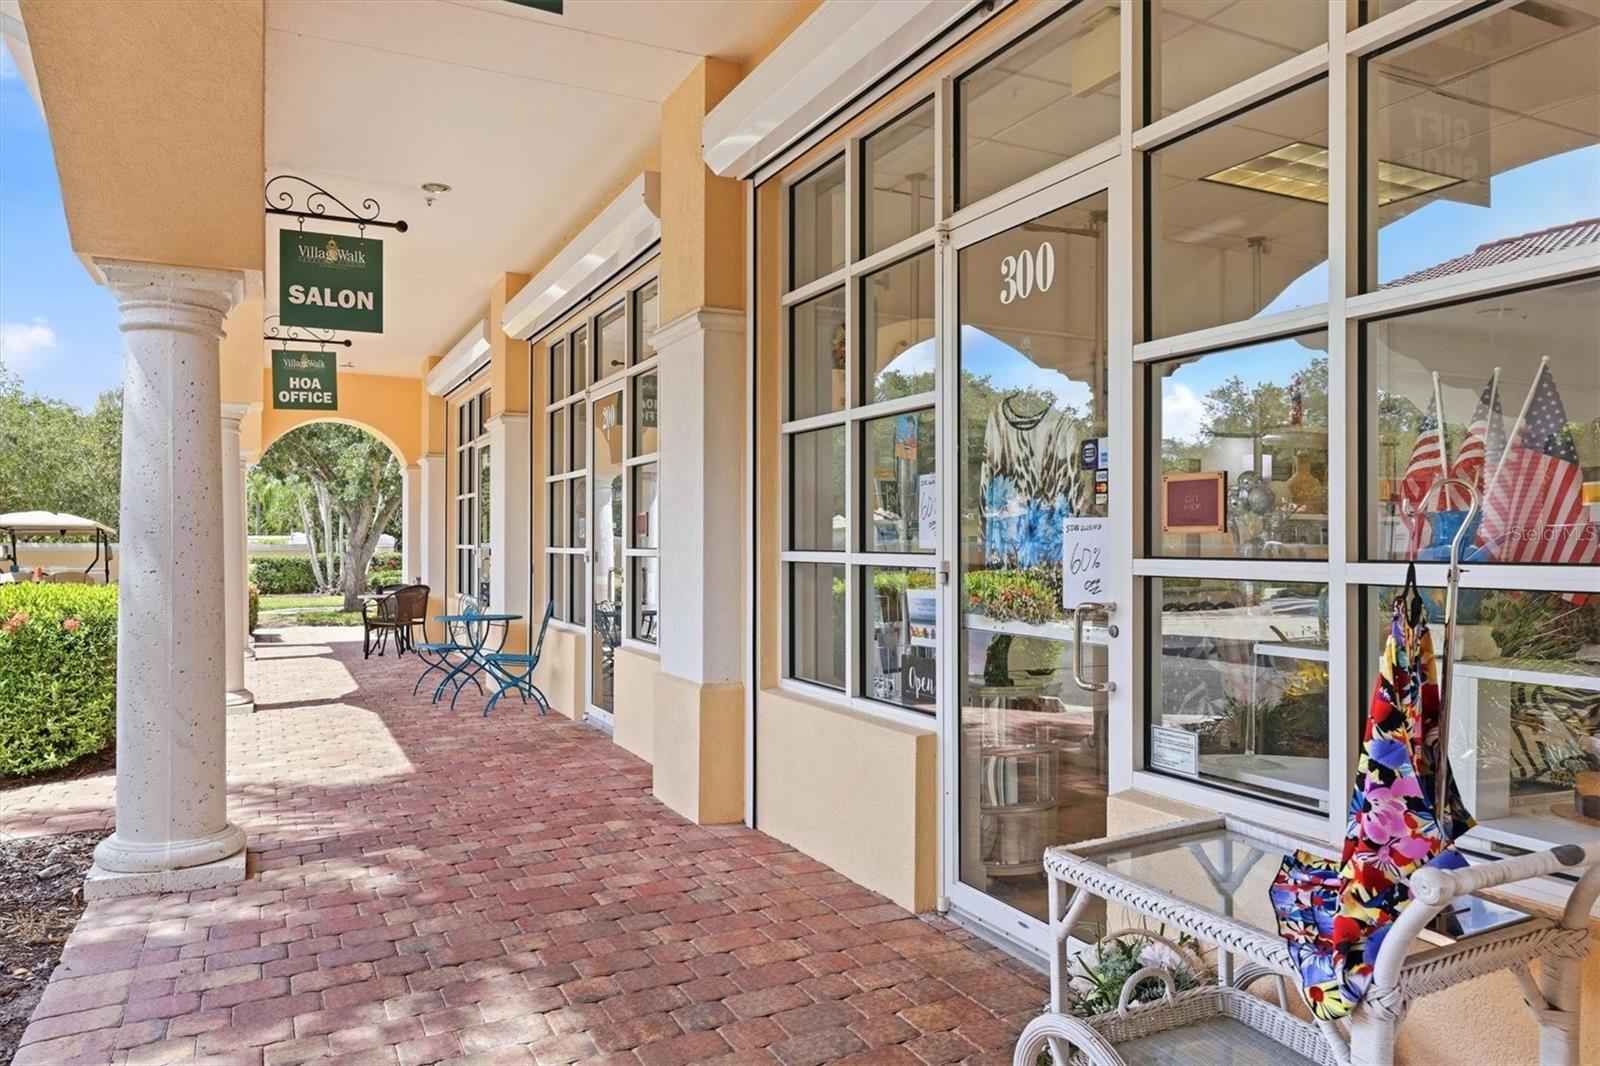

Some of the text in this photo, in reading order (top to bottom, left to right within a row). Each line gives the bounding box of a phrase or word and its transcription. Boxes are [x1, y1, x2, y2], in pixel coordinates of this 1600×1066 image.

[999, 241, 1055, 305] 300
[288, 284, 374, 310] SALON
[283, 358, 326, 369] VillaWalk
[289, 377, 321, 390] HOA
[279, 391, 332, 404] OFFICE
[1070, 542, 1101, 575] 60%
[908, 666, 936, 699] Open
